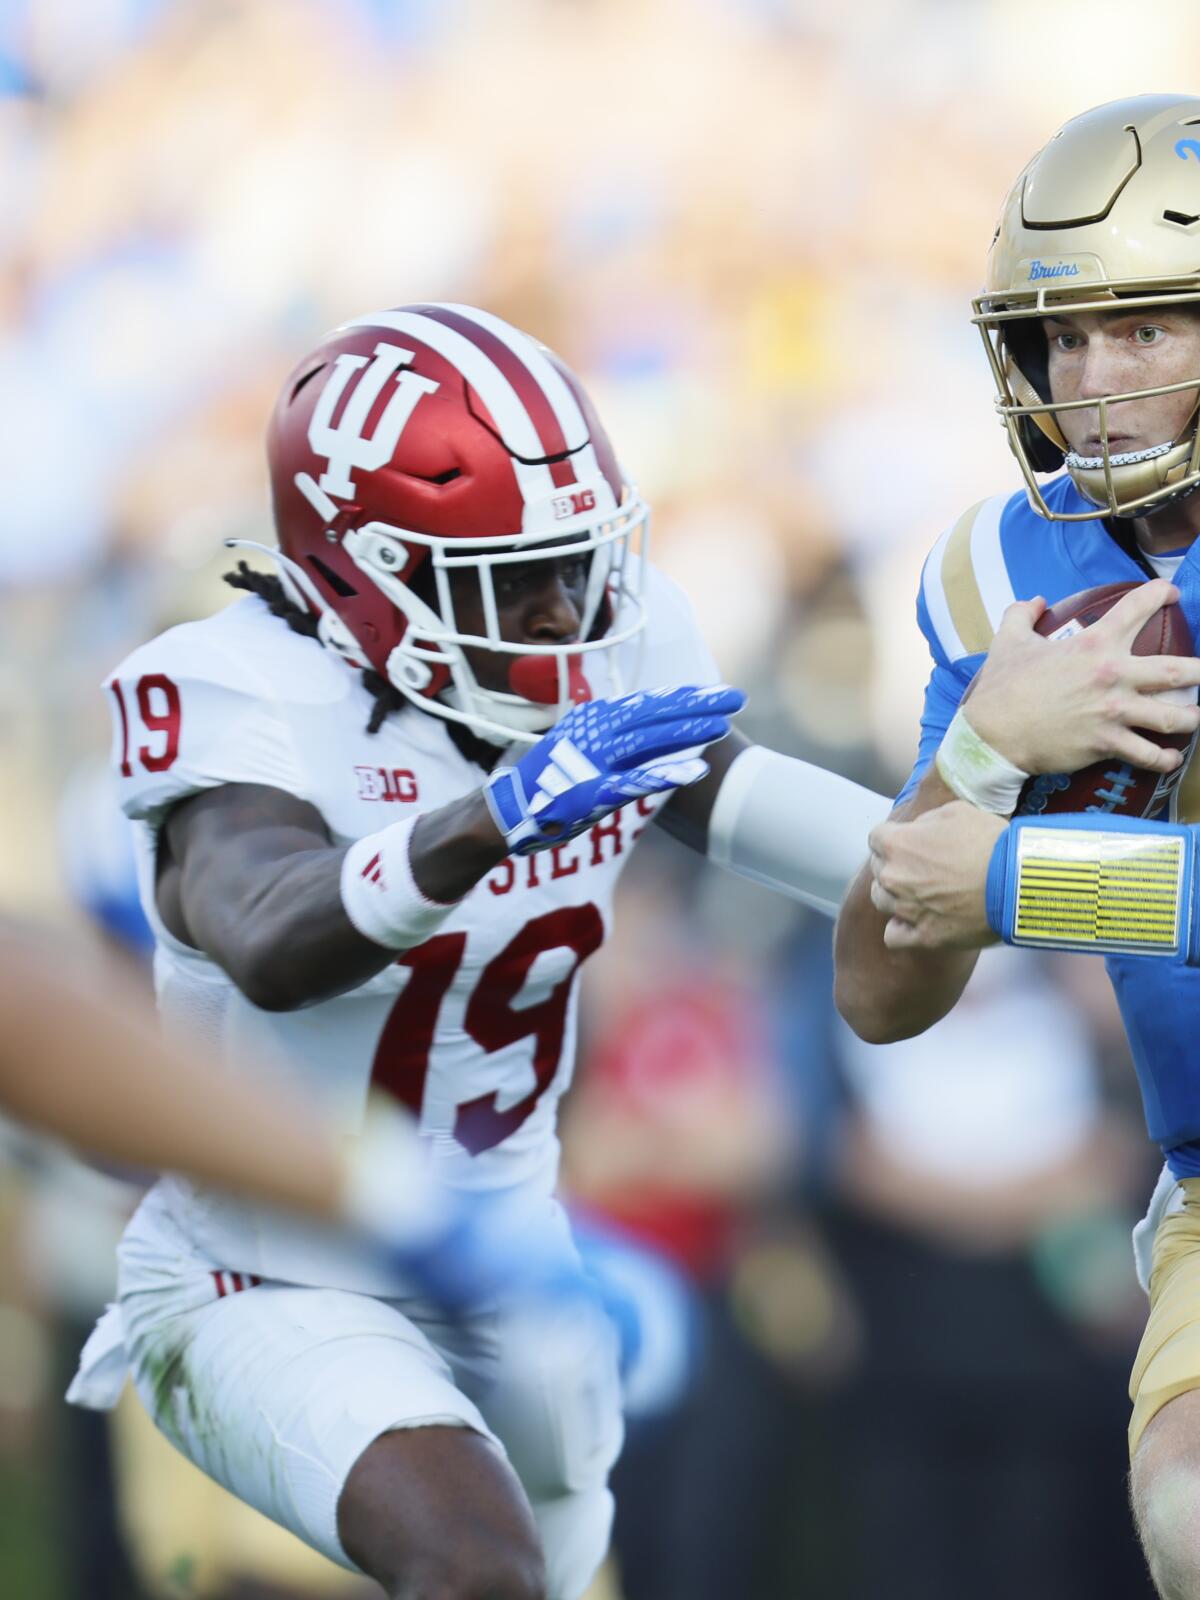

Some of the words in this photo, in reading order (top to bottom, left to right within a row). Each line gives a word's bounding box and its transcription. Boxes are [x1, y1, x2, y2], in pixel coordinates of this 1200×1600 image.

[1028, 260, 1079, 281] Bruins
[110, 672, 182, 778] 19
[368, 900, 605, 1158] 19
